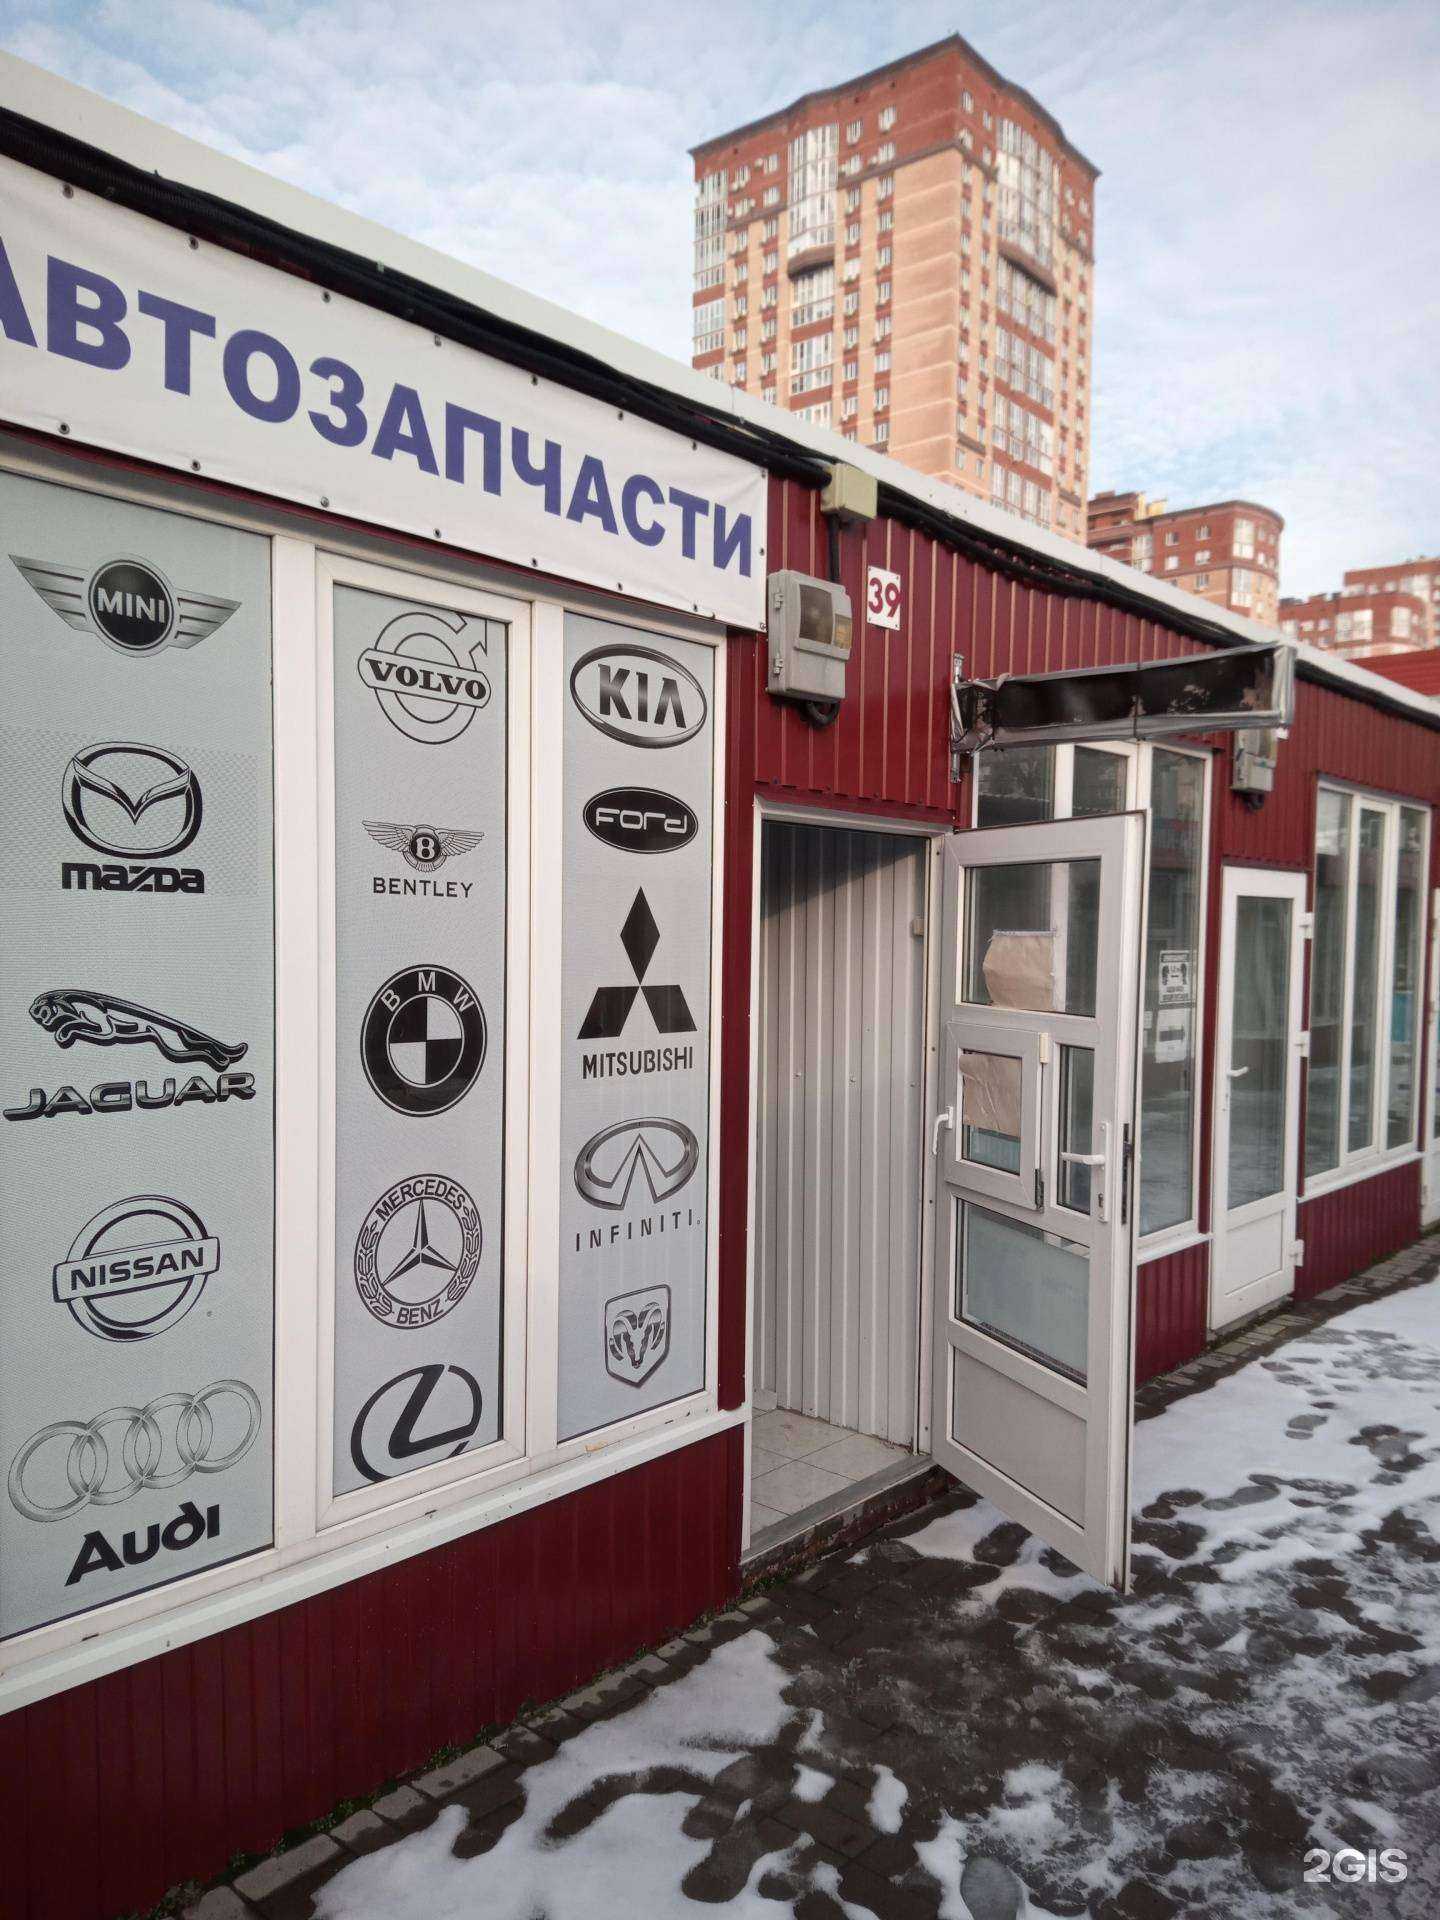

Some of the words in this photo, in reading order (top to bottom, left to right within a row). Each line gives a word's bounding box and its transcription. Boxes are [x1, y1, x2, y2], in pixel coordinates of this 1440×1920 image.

[97, 587, 166, 624] MINI
[868, 577, 900, 618] 39
[365, 658, 487, 700] VOLVO
[597, 663, 687, 729] KIA
[373, 876, 474, 899] BENTLEY
[582, 1046, 694, 1080] MITSUBISHI
[2, 1071, 257, 1122] JAGUAR
[375, 1178, 466, 1222] MERCEDES
[575, 1208, 693, 1252] INFINITI
[70, 1246, 205, 1292] NISSAN
[396, 1298, 445, 1326] BENZ
[64, 1500, 221, 1588] Audi
